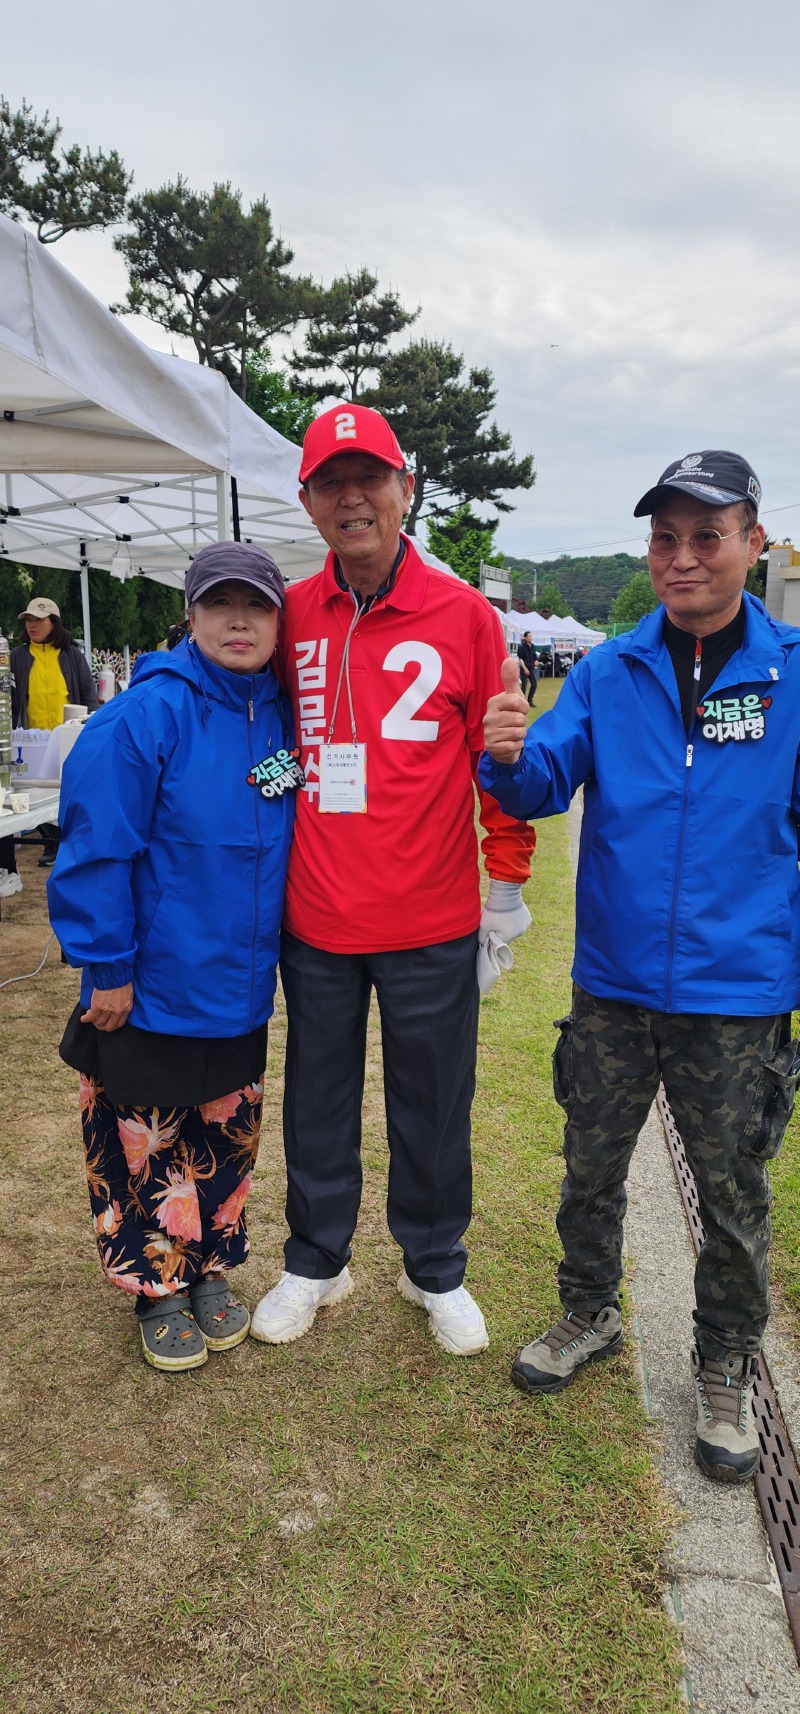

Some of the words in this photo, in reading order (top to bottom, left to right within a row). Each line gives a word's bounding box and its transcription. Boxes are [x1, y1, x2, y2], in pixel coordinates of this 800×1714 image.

[335, 413, 356, 440] 2
[381, 640, 442, 741] 2
[703, 694, 762, 721] 지금은
[702, 715, 765, 742] 이재명
[250, 749, 297, 784] 지금은
[261, 764, 306, 797] 이재명
